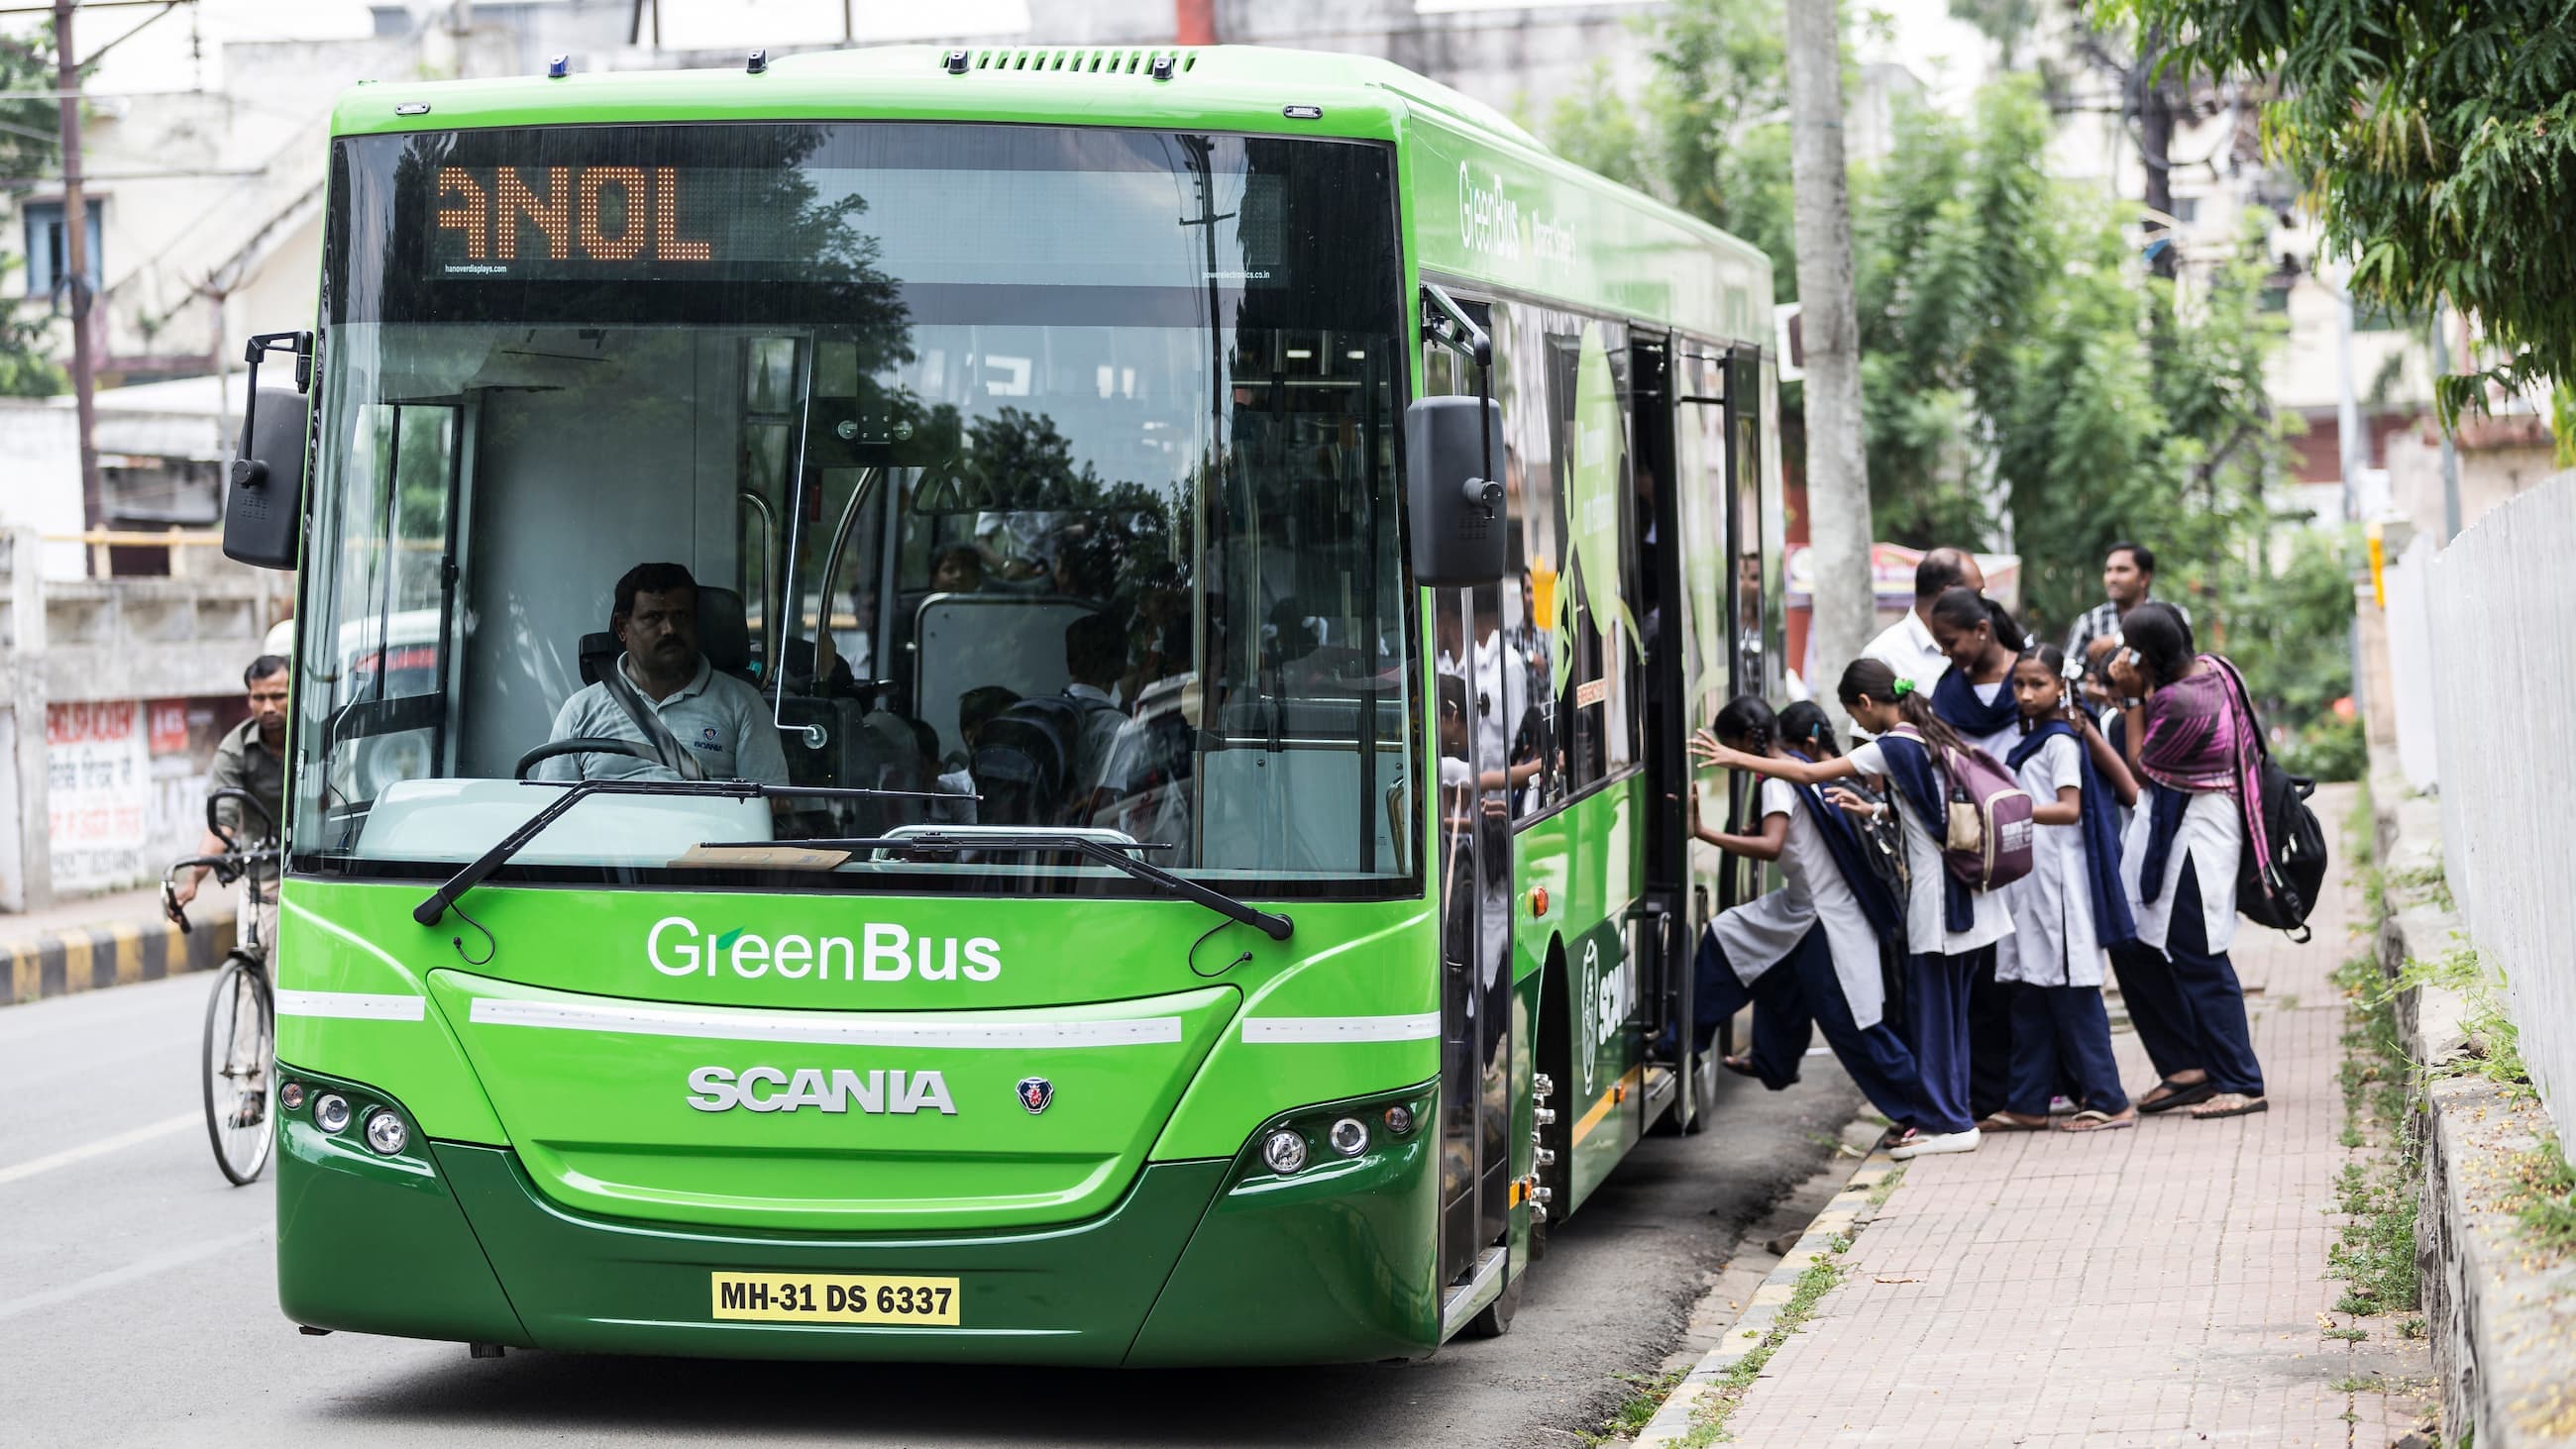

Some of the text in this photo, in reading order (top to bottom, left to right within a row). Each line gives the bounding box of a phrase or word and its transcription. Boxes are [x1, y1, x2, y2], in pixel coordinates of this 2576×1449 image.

[1458, 159, 1520, 261] GreenBus
[445, 263, 507, 274] hanoverdisplays.com
[1202, 269, 1270, 279] powerelectronics.co.in
[647, 917, 1002, 982] GreenBus
[686, 1067, 958, 1115] SCANIA
[720, 1282, 952, 1315] MH-31 DS 6337
